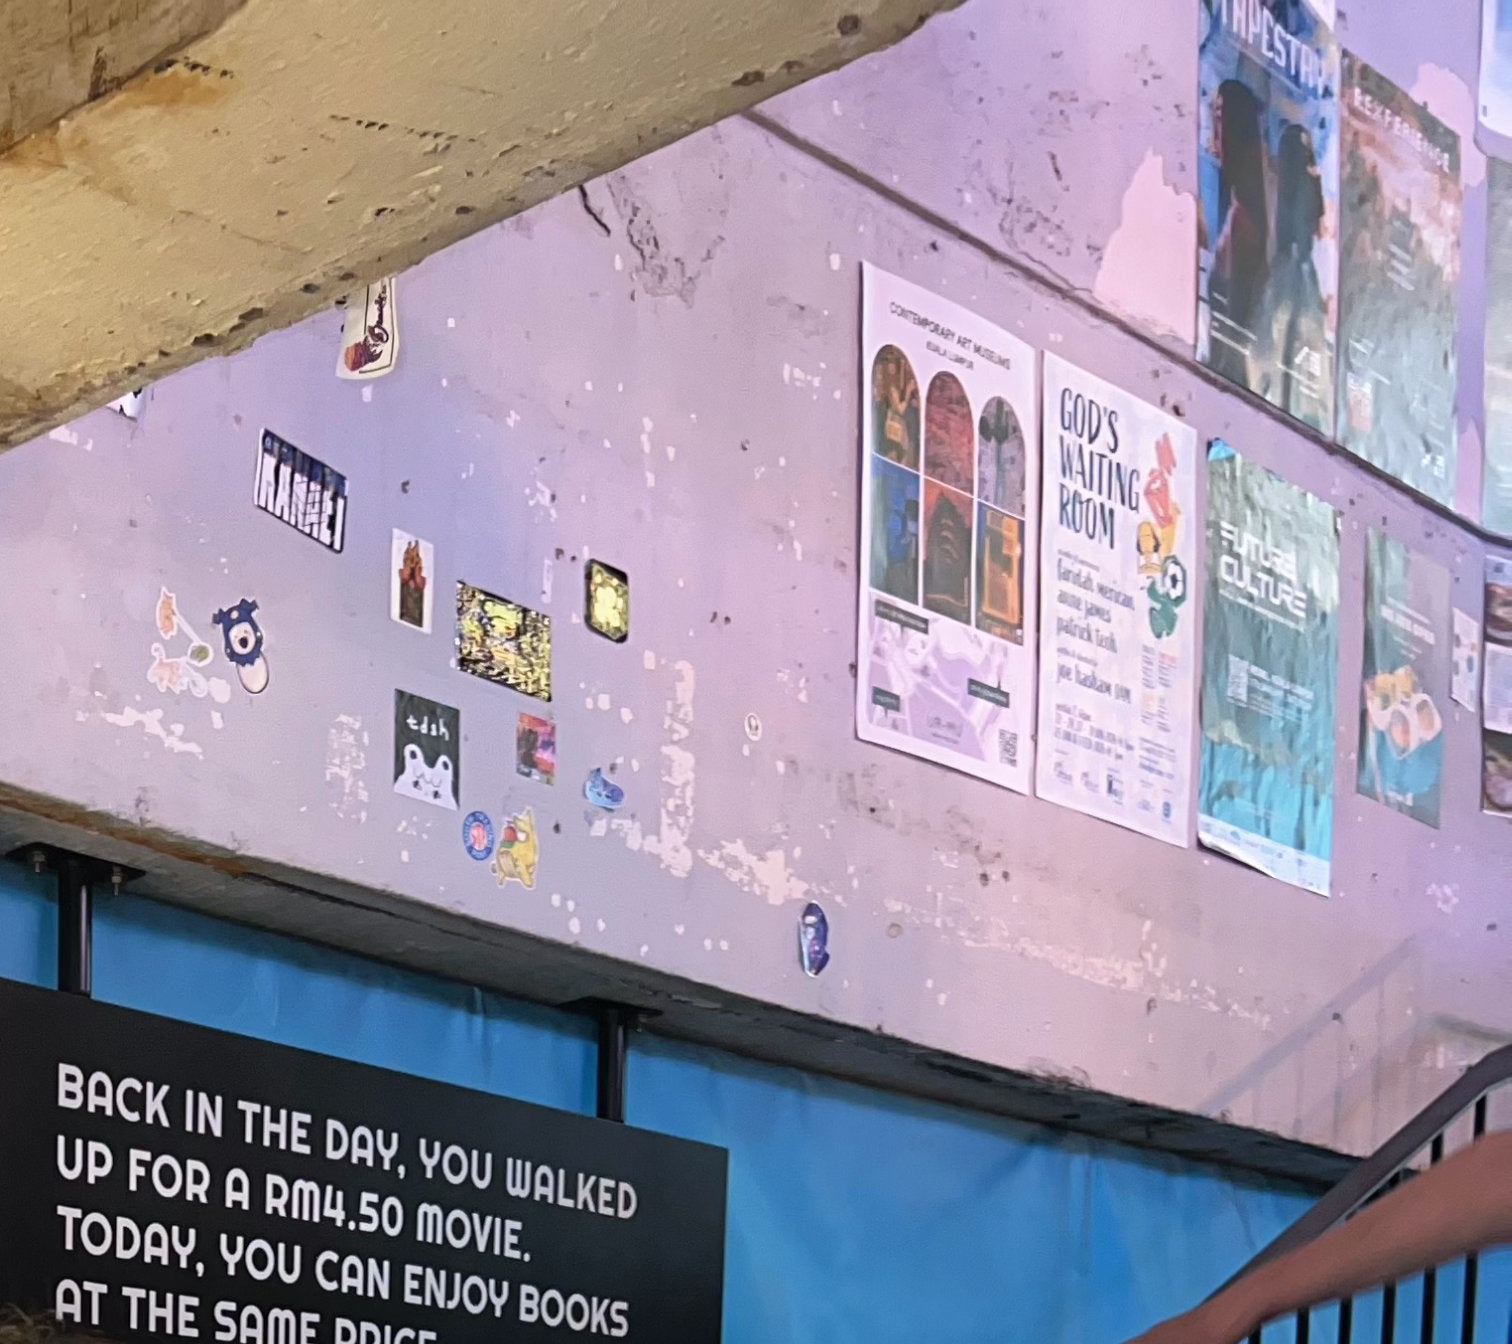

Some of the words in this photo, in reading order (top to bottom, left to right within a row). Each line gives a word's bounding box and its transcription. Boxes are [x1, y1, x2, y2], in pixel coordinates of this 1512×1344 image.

[1060, 387, 1118, 453] GOD'S
[1059, 434, 1139, 514] WAITING
[1059, 482, 1115, 549] ROOM
[1220, 519, 1297, 583] FUTURE
[1219, 554, 1307, 618] CULTURE
[57, 1063, 169, 1128] BACK
[186, 1089, 222, 1137] IN
[237, 1100, 311, 1155] THE
[326, 1119, 406, 1179] DAY,
[419, 1139, 492, 1189] YOU
[506, 1158, 637, 1219] WALKED
[57, 1135, 113, 1184] UP
[128, 1149, 210, 1204] FOR
[225, 1168, 250, 1210] A
[266, 1174, 403, 1237] RM4.50
[417, 1203, 531, 1262] MOVIE.
[57, 1205, 205, 1277] TODAY,
[220, 1234, 301, 1283] YOU
[316, 1251, 390, 1300] CAN
[404, 1267, 509, 1318] ENJOY
[519, 1287, 628, 1338] BOOKS
[55, 1279, 107, 1324] AT
[122, 1287, 199, 1338] THE
